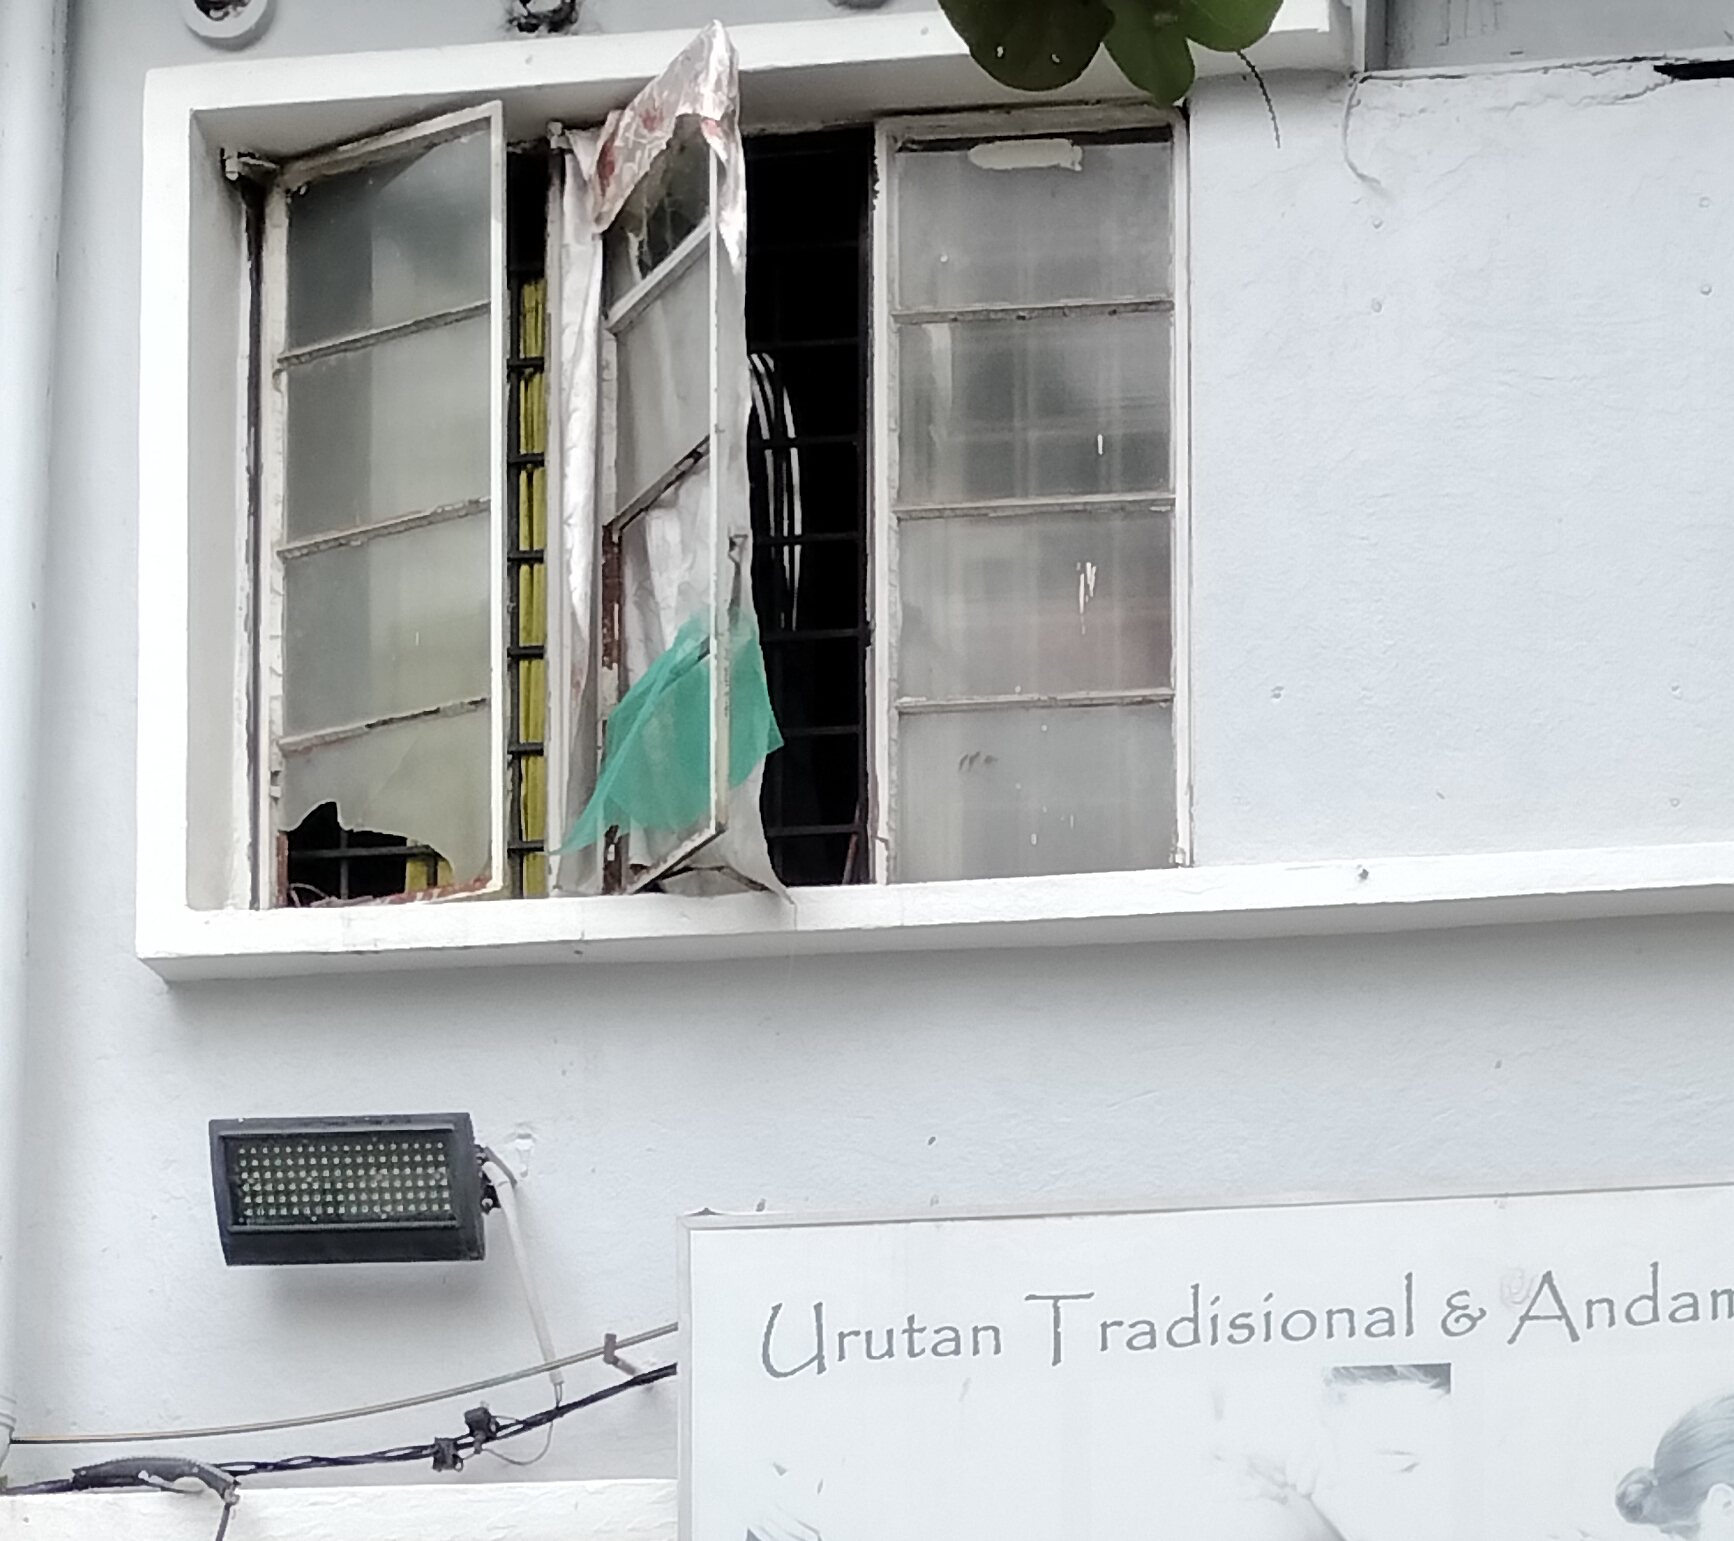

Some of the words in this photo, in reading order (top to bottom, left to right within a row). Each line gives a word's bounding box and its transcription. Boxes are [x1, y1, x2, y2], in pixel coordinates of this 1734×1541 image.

[761, 1301, 1002, 1379] Urutan
[1023, 1271, 1415, 1367] Tradisional
[1440, 1289, 1487, 1338] &
